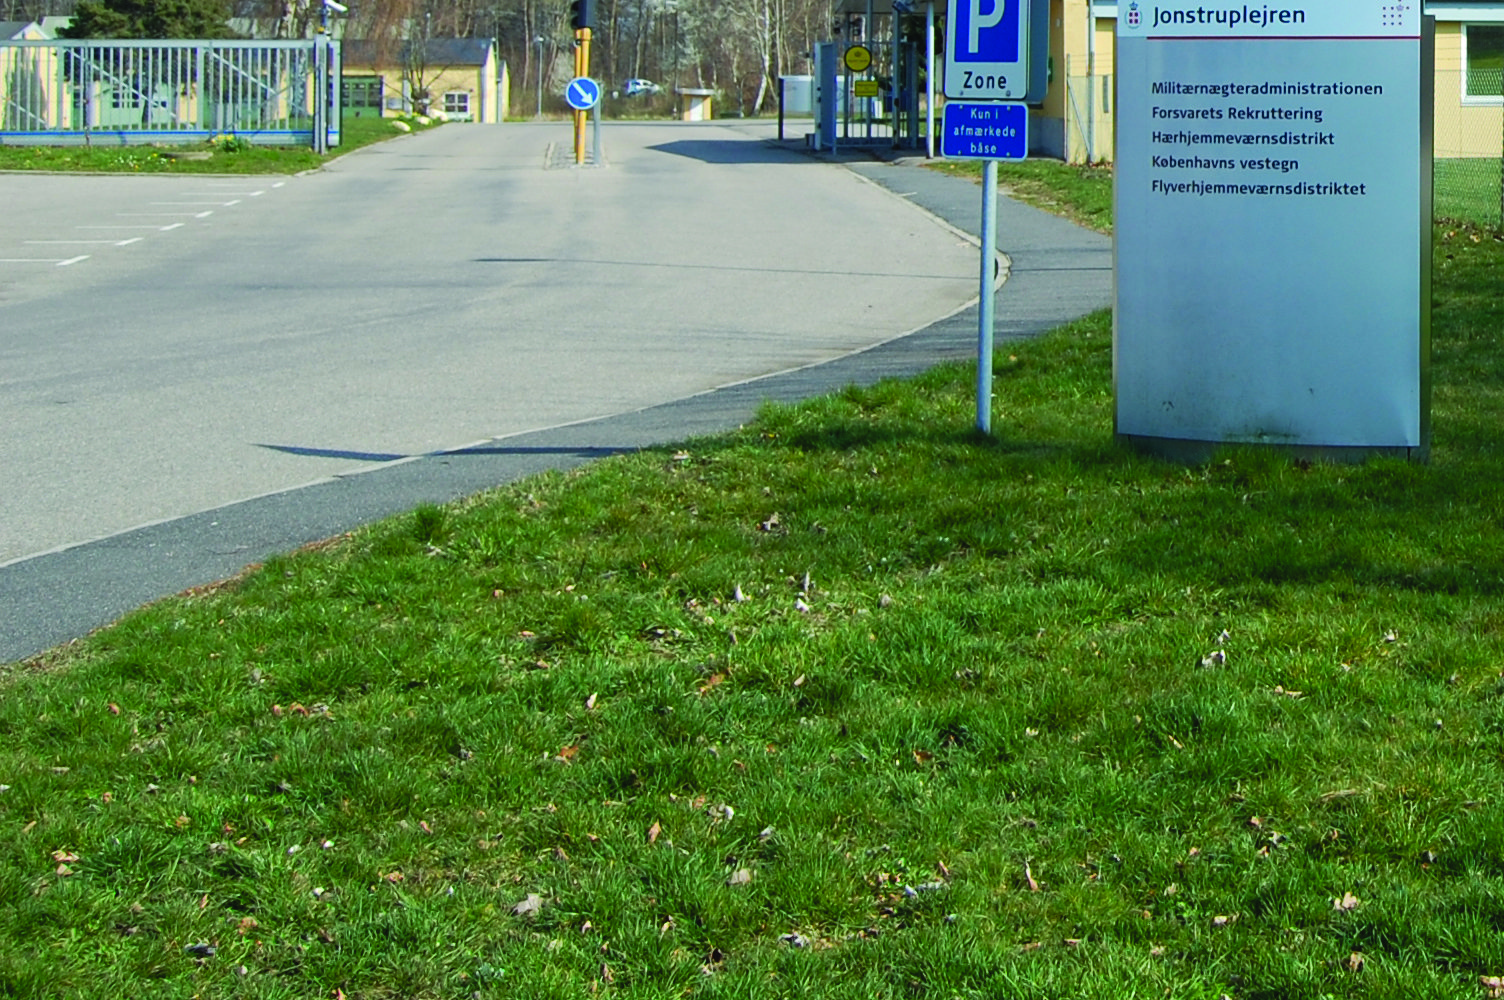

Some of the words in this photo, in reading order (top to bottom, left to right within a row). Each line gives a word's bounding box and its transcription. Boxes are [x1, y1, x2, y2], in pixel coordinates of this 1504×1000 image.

[1152, 5, 1305, 28] Jonstruplejren
[963, 71, 1007, 89] Zone
[1151, 81, 1383, 98] Militærnægteradministrationen
[970, 108, 991, 120] Kun
[1152, 106, 1223, 120] Forsvarets
[1228, 107, 1323, 123] Rekruttering
[953, 124, 1016, 138] afmærkede
[1152, 131, 1335, 147] Hærhjemmeværnsdistrikt
[970, 142, 997, 154] båse
[1152, 155, 1235, 170] Københavns
[1240, 157, 1299, 173] vestegn
[1152, 179, 1366, 197] Flyverhjemmeværnsdistriktet
